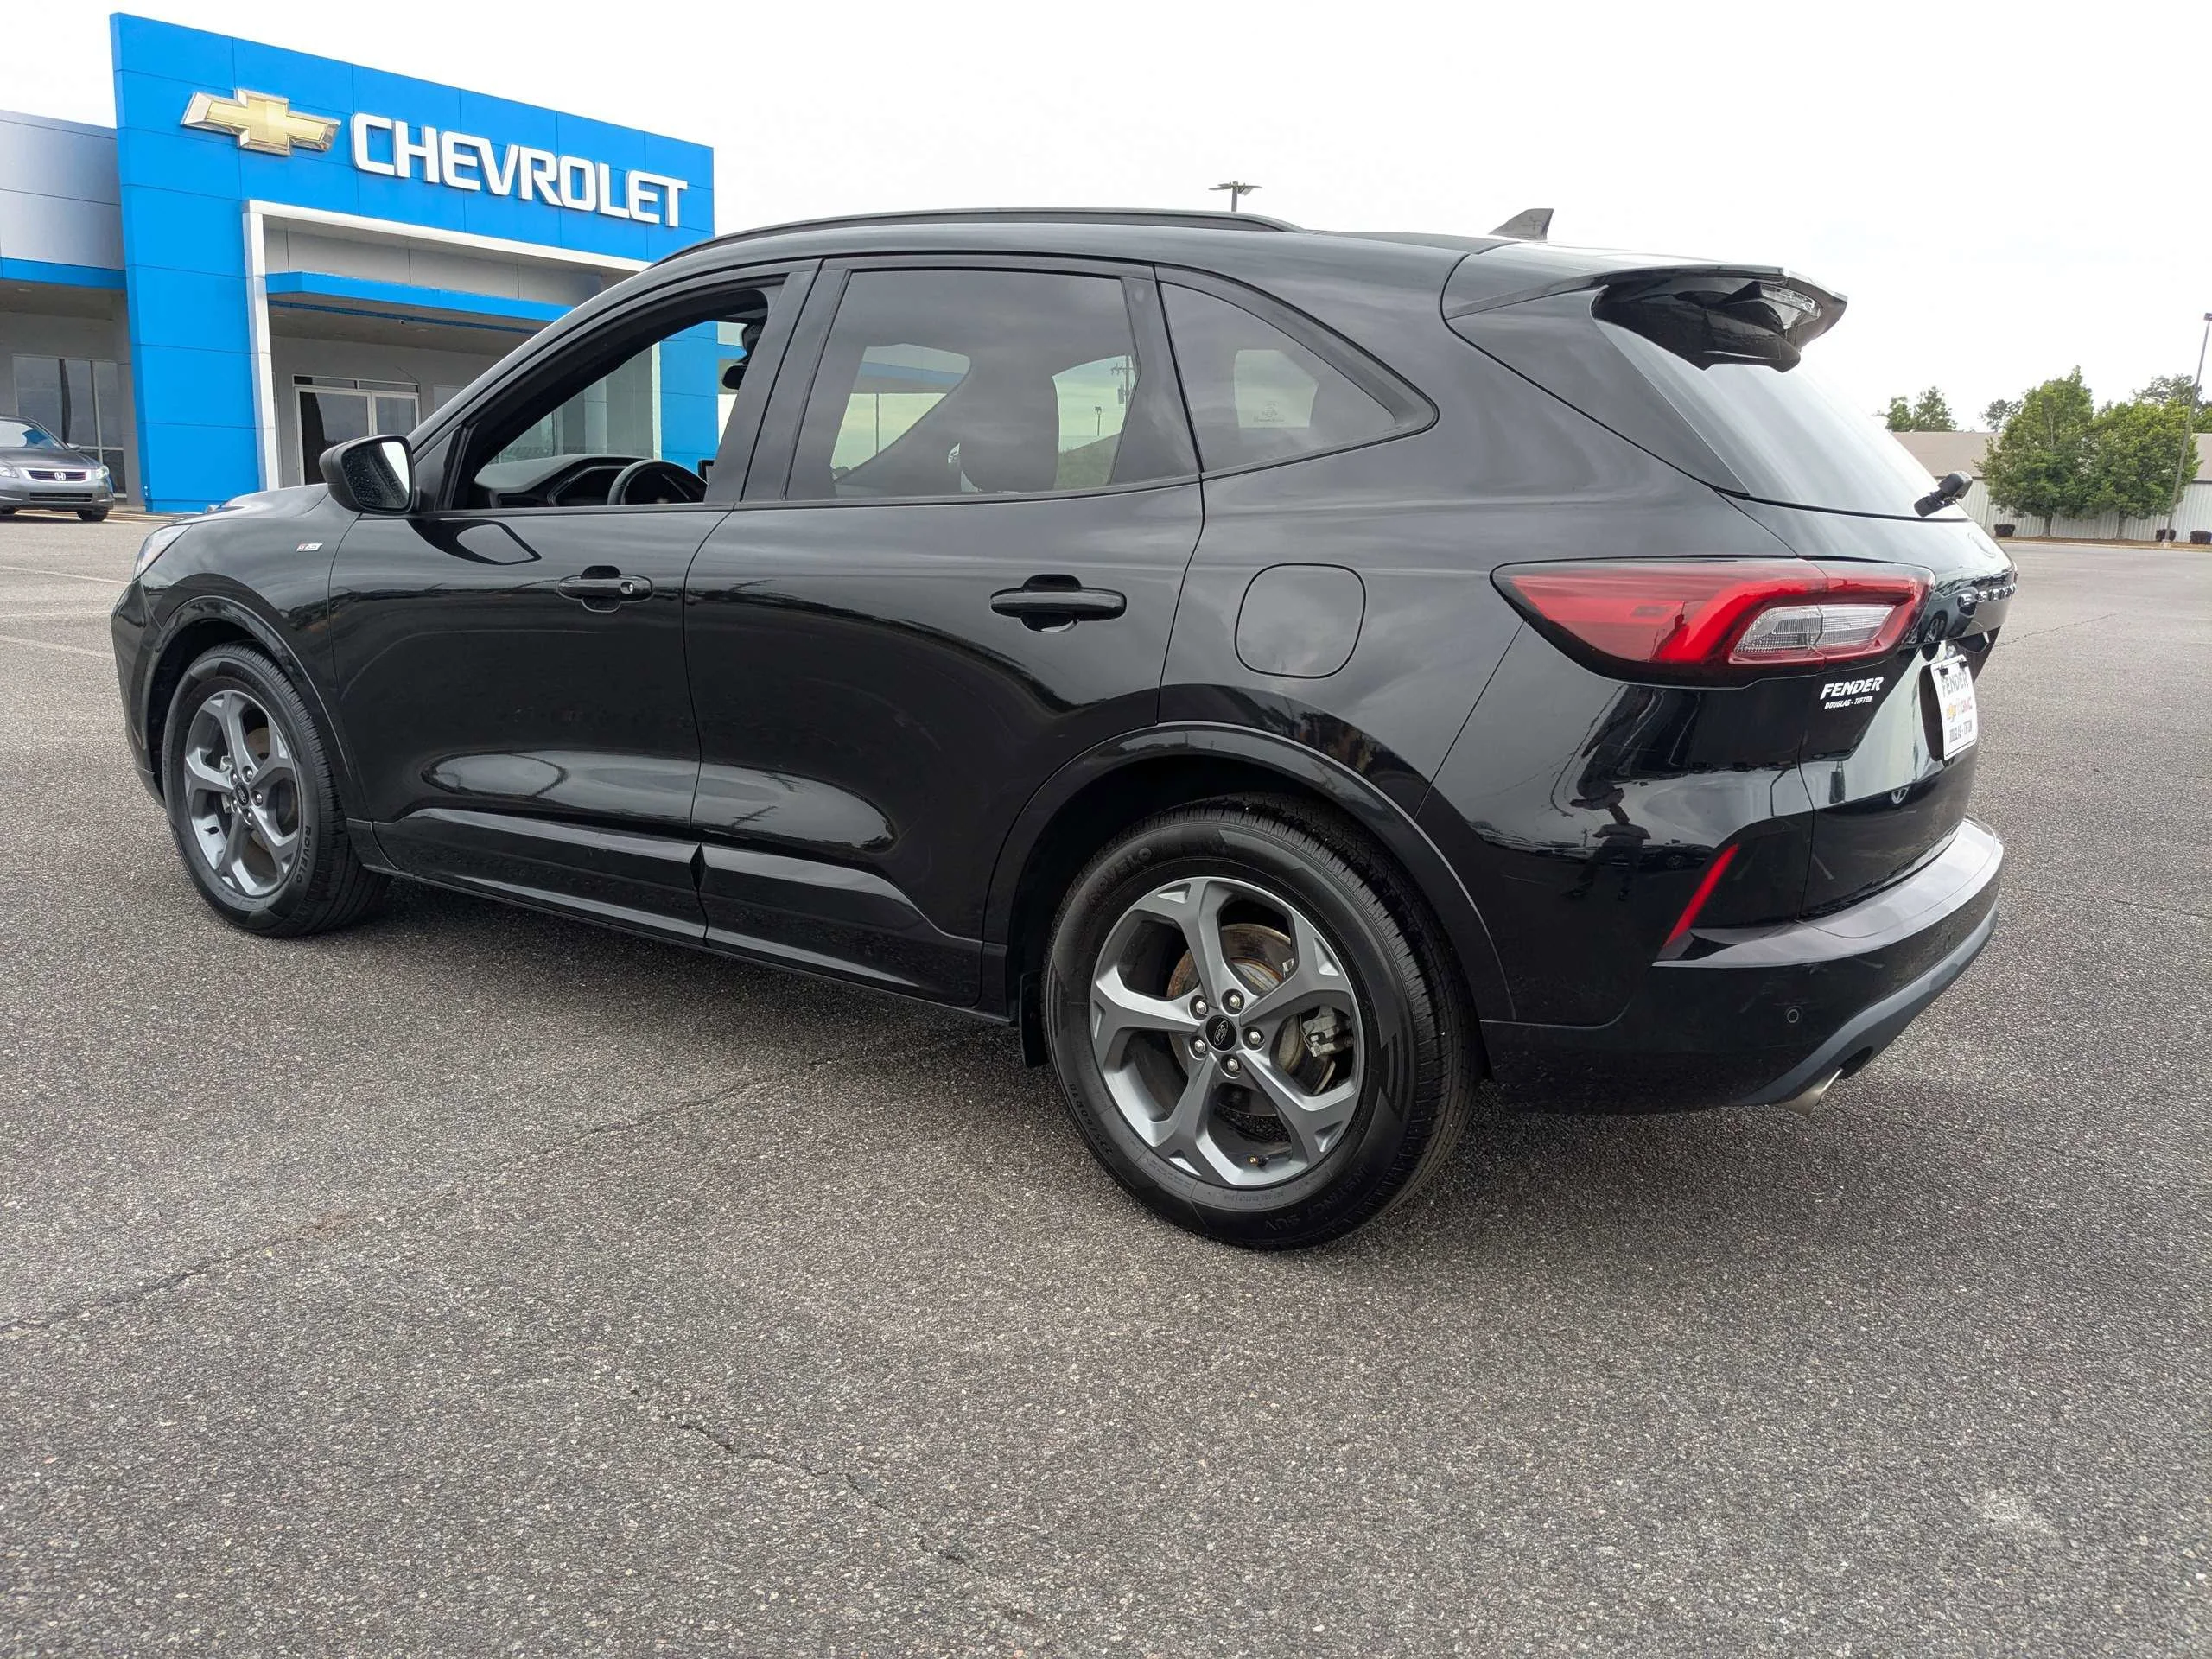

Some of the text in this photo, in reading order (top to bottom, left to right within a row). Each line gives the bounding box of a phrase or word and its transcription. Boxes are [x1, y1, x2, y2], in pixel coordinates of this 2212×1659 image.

[350, 112, 688, 227] CHEVROLET
[1820, 677, 1884, 700] FENDER
[1824, 698, 1852, 709] DOUGLAS
[296, 825, 312, 883] ROVELO
[1264, 1213, 1300, 1231] SUV
